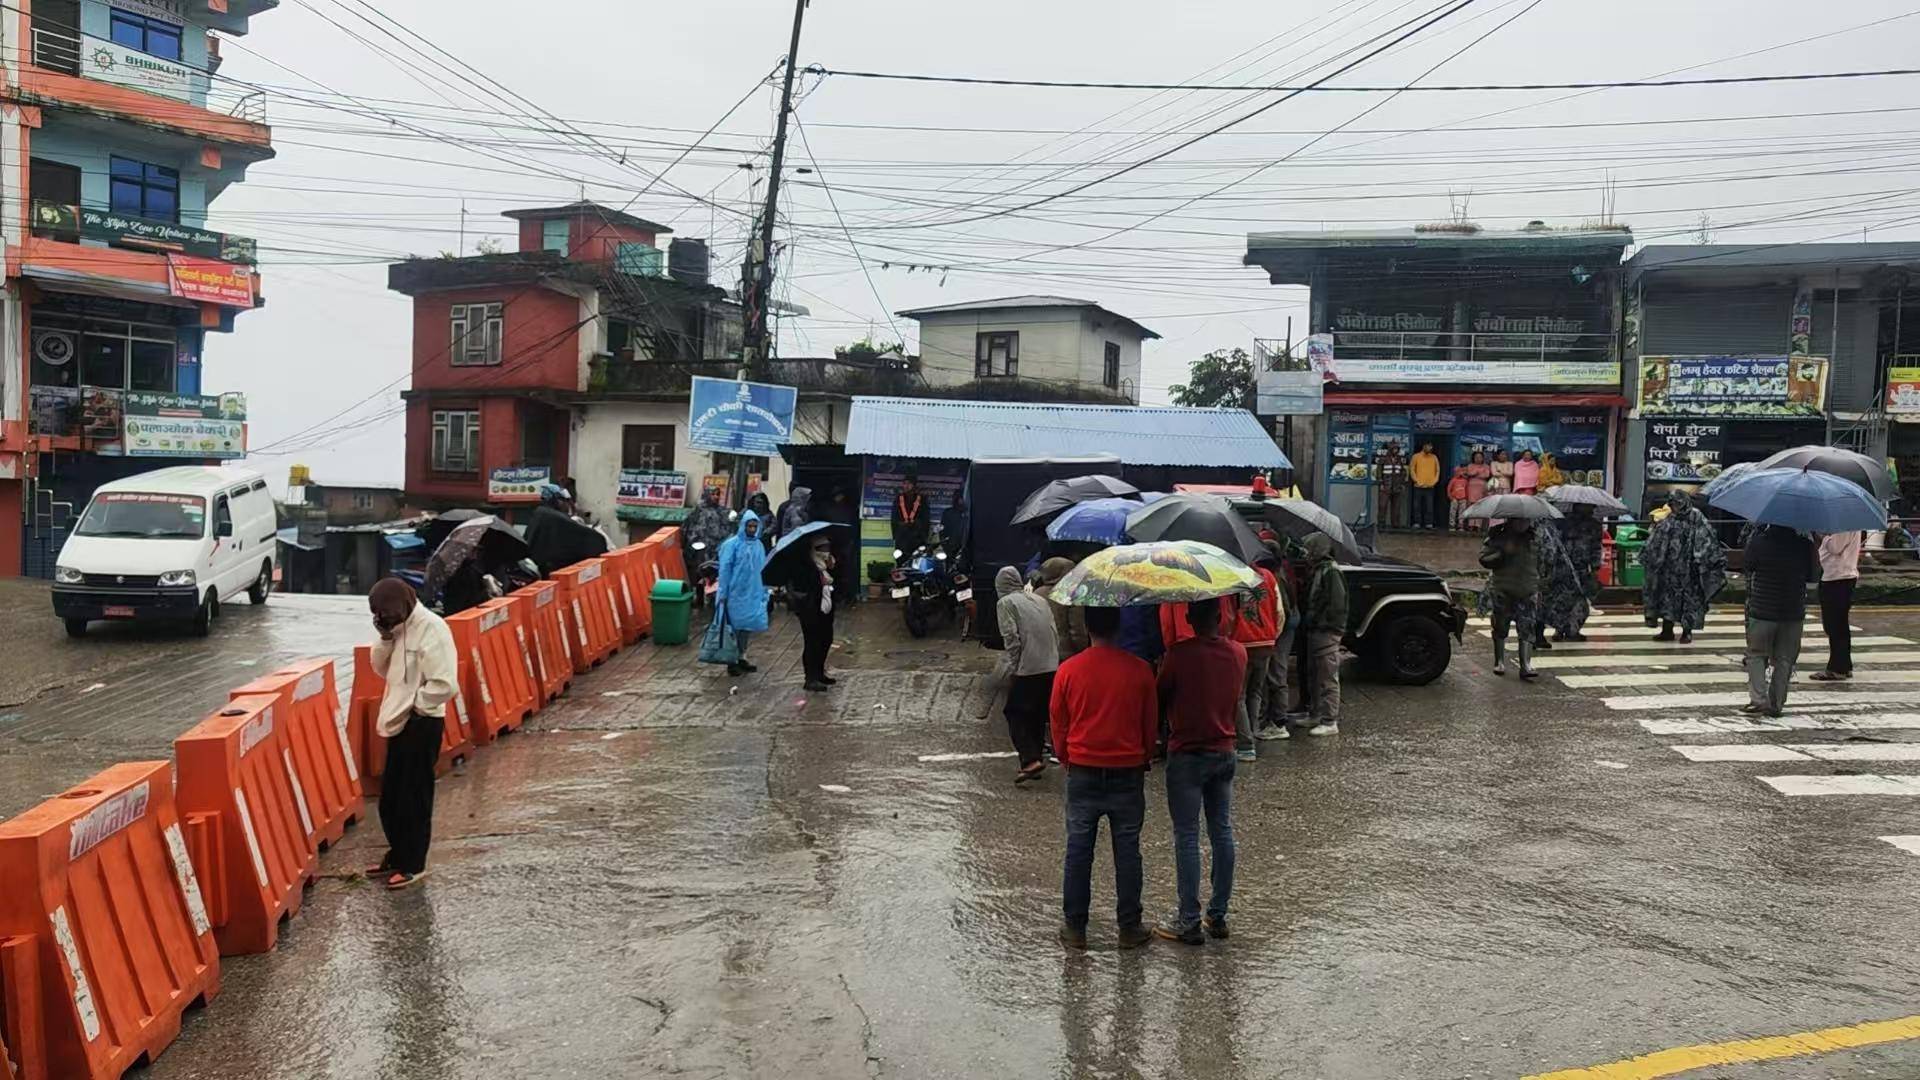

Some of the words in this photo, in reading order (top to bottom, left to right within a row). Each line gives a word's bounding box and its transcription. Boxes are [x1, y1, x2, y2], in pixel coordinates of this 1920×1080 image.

[125, 55, 186, 78] BHRIKUTI
[83, 212, 102, 225] The
[103, 217, 128, 232] Style
[129, 221, 154, 234] Zone
[155, 225, 191, 240] Unisex
[191, 233, 217, 243] Salon
[1703, 363, 1722, 375] हेयर
[127, 394, 139, 403] The
[157, 396, 174, 407] Zone
[1685, 423, 1720, 436] होटल
[1334, 432, 1365, 443] खाजा
[1666, 435, 1699, 449] एण्ड
[1333, 446, 1362, 458] घर
